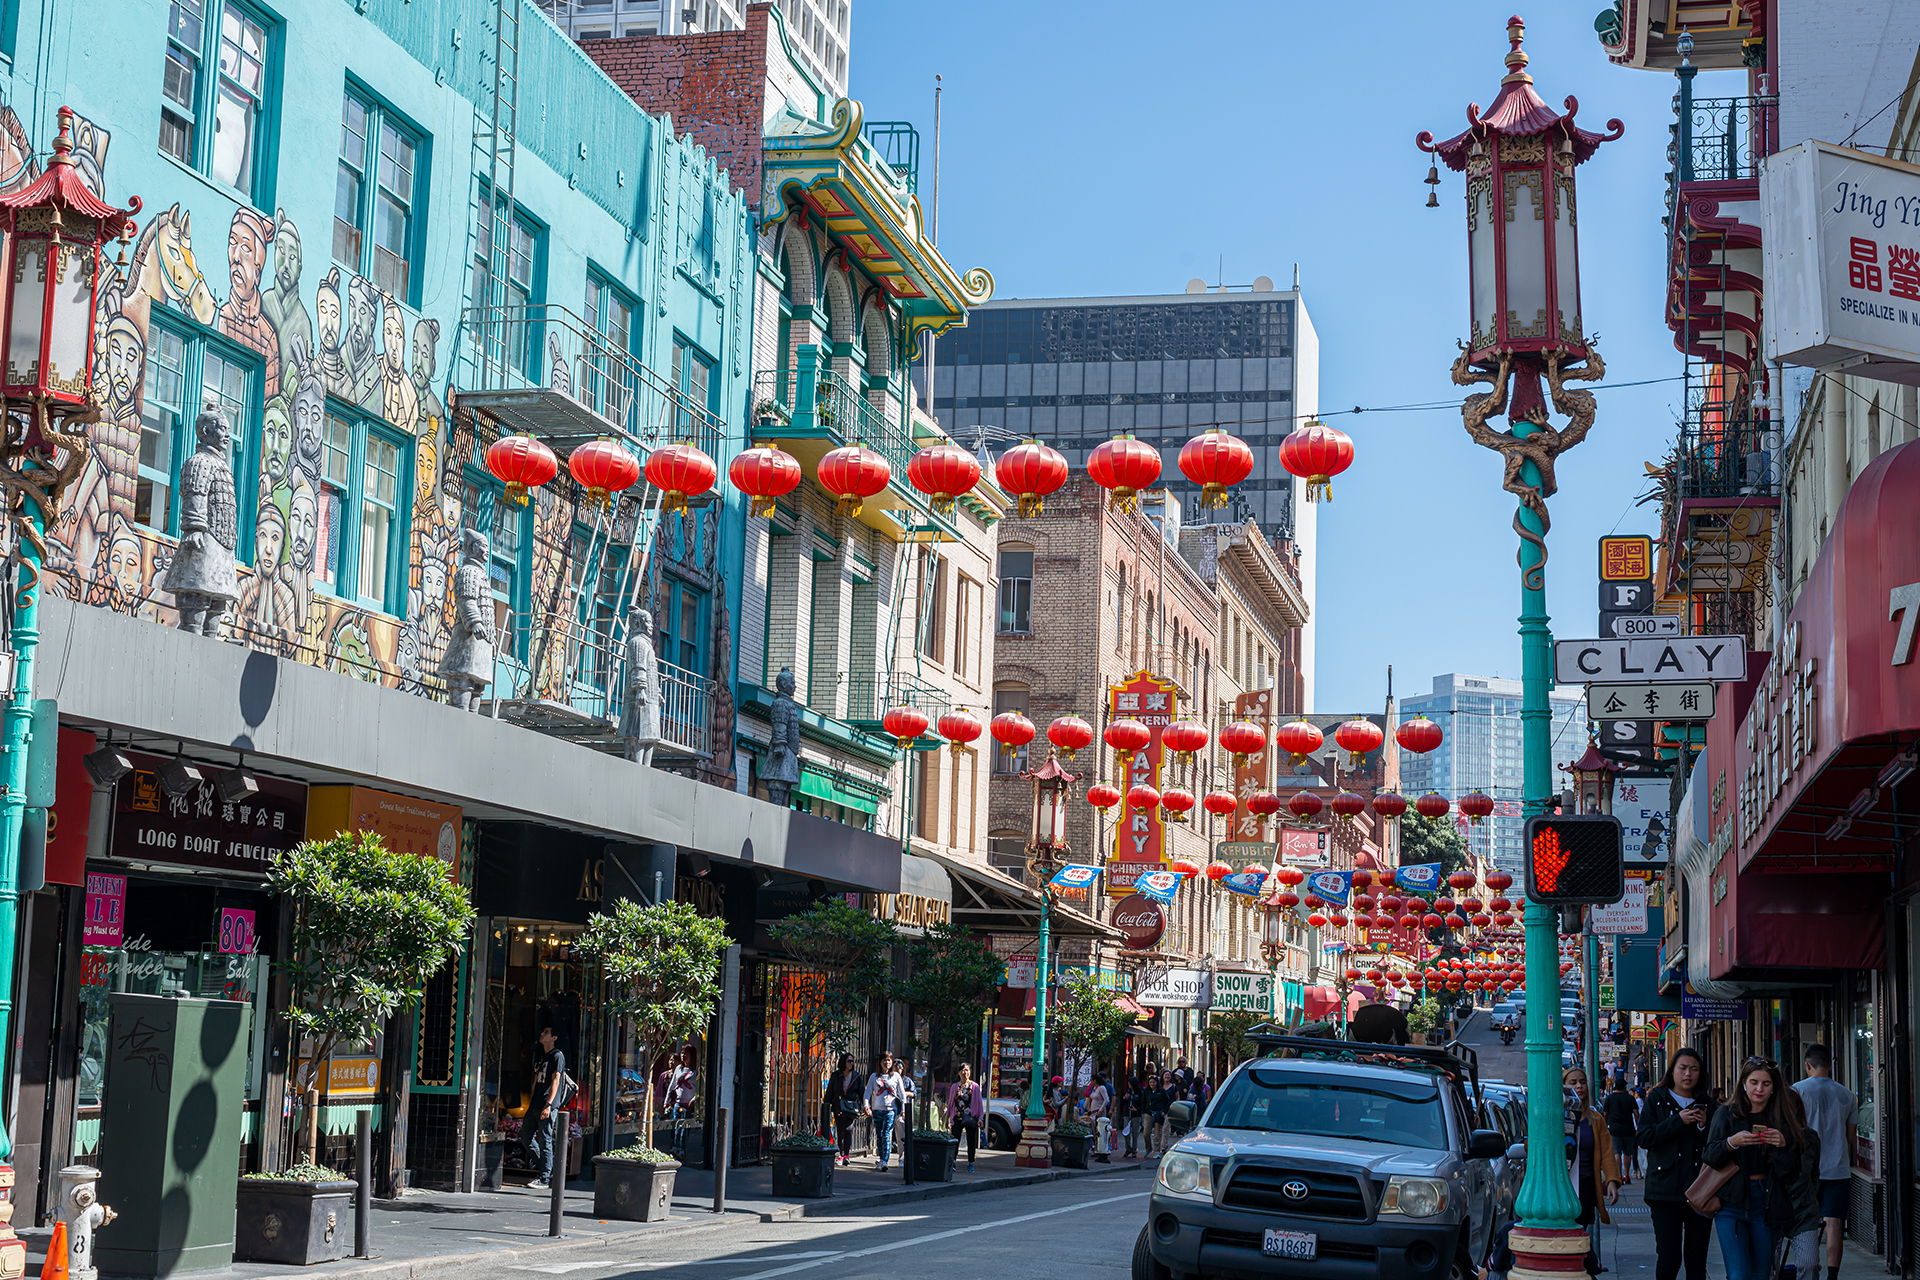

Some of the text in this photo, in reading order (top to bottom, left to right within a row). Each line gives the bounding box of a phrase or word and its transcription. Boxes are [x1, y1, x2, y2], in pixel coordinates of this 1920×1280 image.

[1834, 181, 1887, 228] Jing
[1840, 297, 1895, 321] SPECIALIZE
[1899, 309, 1908, 324] IN
[1625, 620, 1657, 634] 800
[1577, 645, 1725, 675] CLAY
[1603, 689, 1701, 715] 企李街
[1131, 742, 1152, 853] AKRY
[1620, 785, 1640, 802] 德
[1640, 810, 1671, 819] EAS
[138, 828, 177, 849] LONG
[184, 835, 221, 855] BOAT
[1286, 832, 1316, 852] Kan's
[1112, 864, 1155, 874] CHINESE
[1626, 884, 1643, 894] KING
[895, 892, 950, 928] SHANGHAI
[1624, 899, 1630, 908] 6
[93, 926, 107, 935] Must
[226, 959, 252, 979] Sale
[1174, 980, 1204, 994] SHOP
[1217, 975, 1251, 992] SNOW
[223, 982, 251, 1003] Sale
[1145, 992, 1202, 1002] www.wokshop.com
[1211, 993, 1254, 1010] GARDEN
[1265, 1237, 1314, 1255] 8S18687
